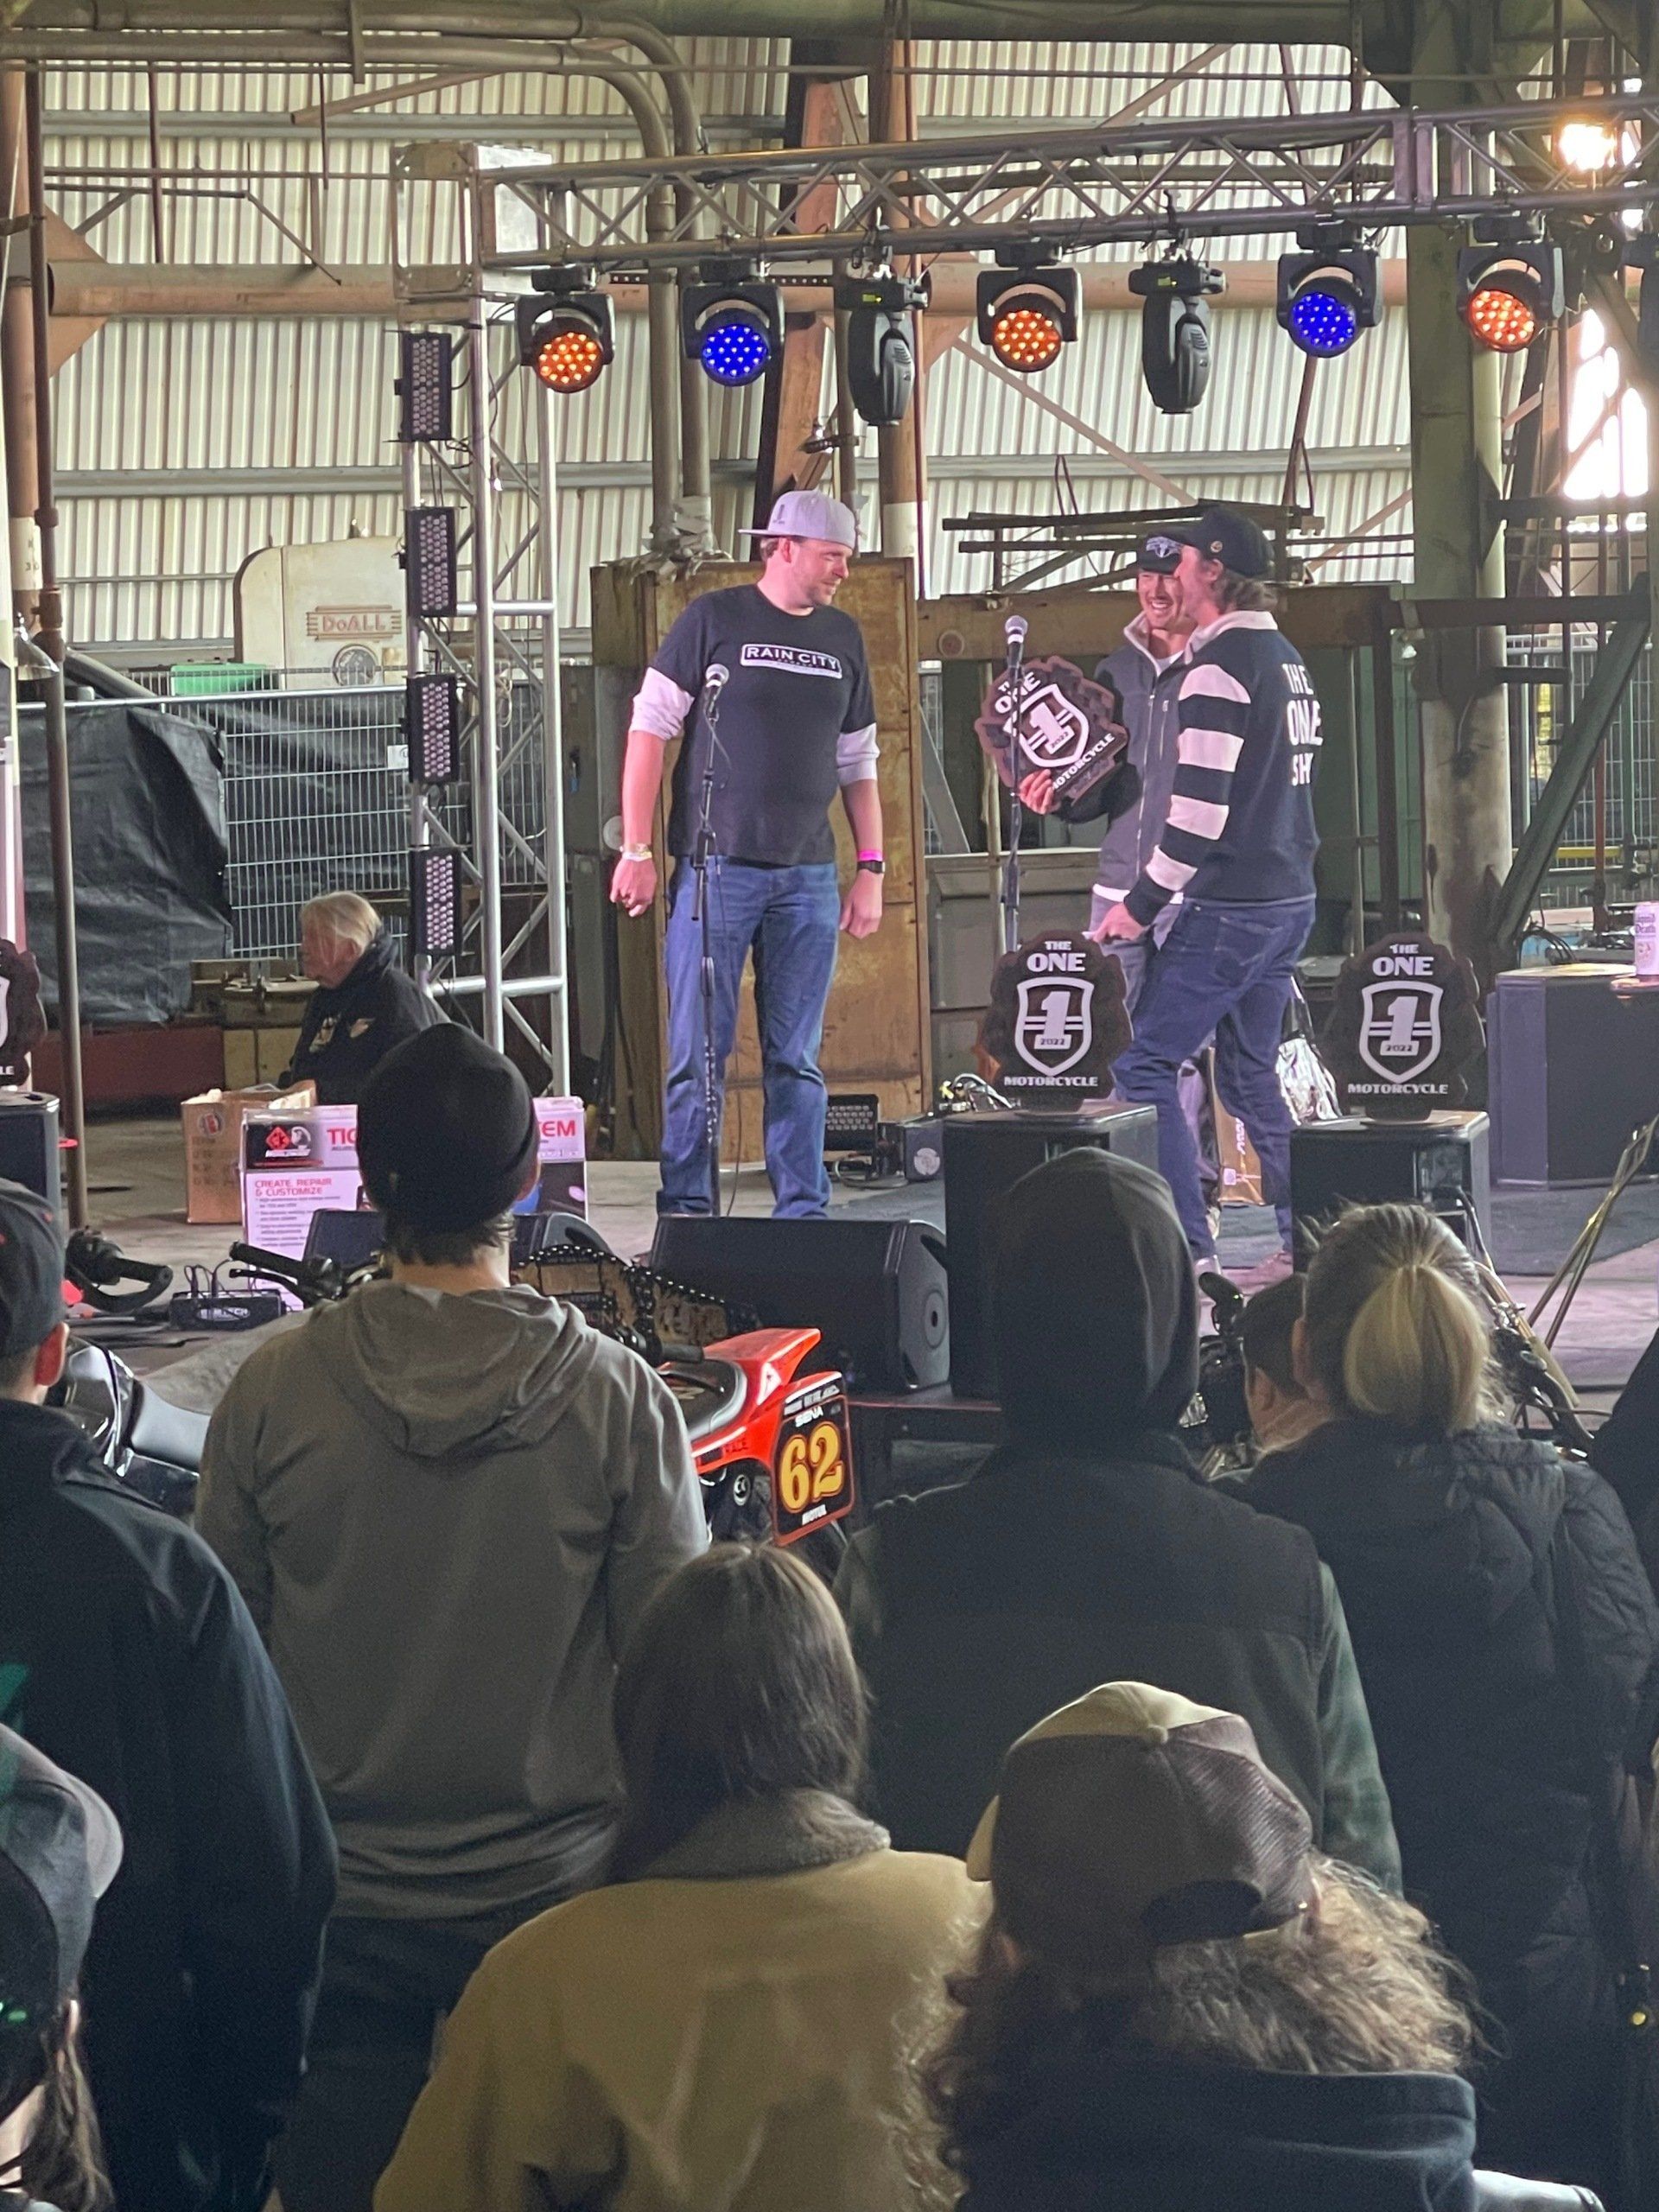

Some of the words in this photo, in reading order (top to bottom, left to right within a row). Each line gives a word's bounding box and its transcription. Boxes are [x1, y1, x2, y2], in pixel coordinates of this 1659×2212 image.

[322, 613, 386, 632] DoALL
[746, 646, 794, 661] RAIN
[798, 653, 838, 671] CITY
[1281, 663, 1314, 696] THE
[1029, 702, 1076, 755] 1
[1287, 699, 1324, 747] ONE
[1044, 940, 1072, 951] THE
[1389, 943, 1420, 955] THE
[1027, 952, 1087, 973] ONE
[1372, 956, 1434, 977] ONE
[1034, 990, 1072, 1050] 1
[1380, 996, 1420, 1056] 1
[1039, 1038, 1066, 1046] 2022
[1385, 1044, 1414, 1052] 2022
[1003, 1076, 1099, 1087] MOTORCYCLE
[1347, 1083, 1449, 1095] MOTORCYCLE
[265, 1186, 323, 1197] CUSTOMIZE
[296, 1177, 333, 1186] REPAIR
[780, 1421, 844, 1513] 62
